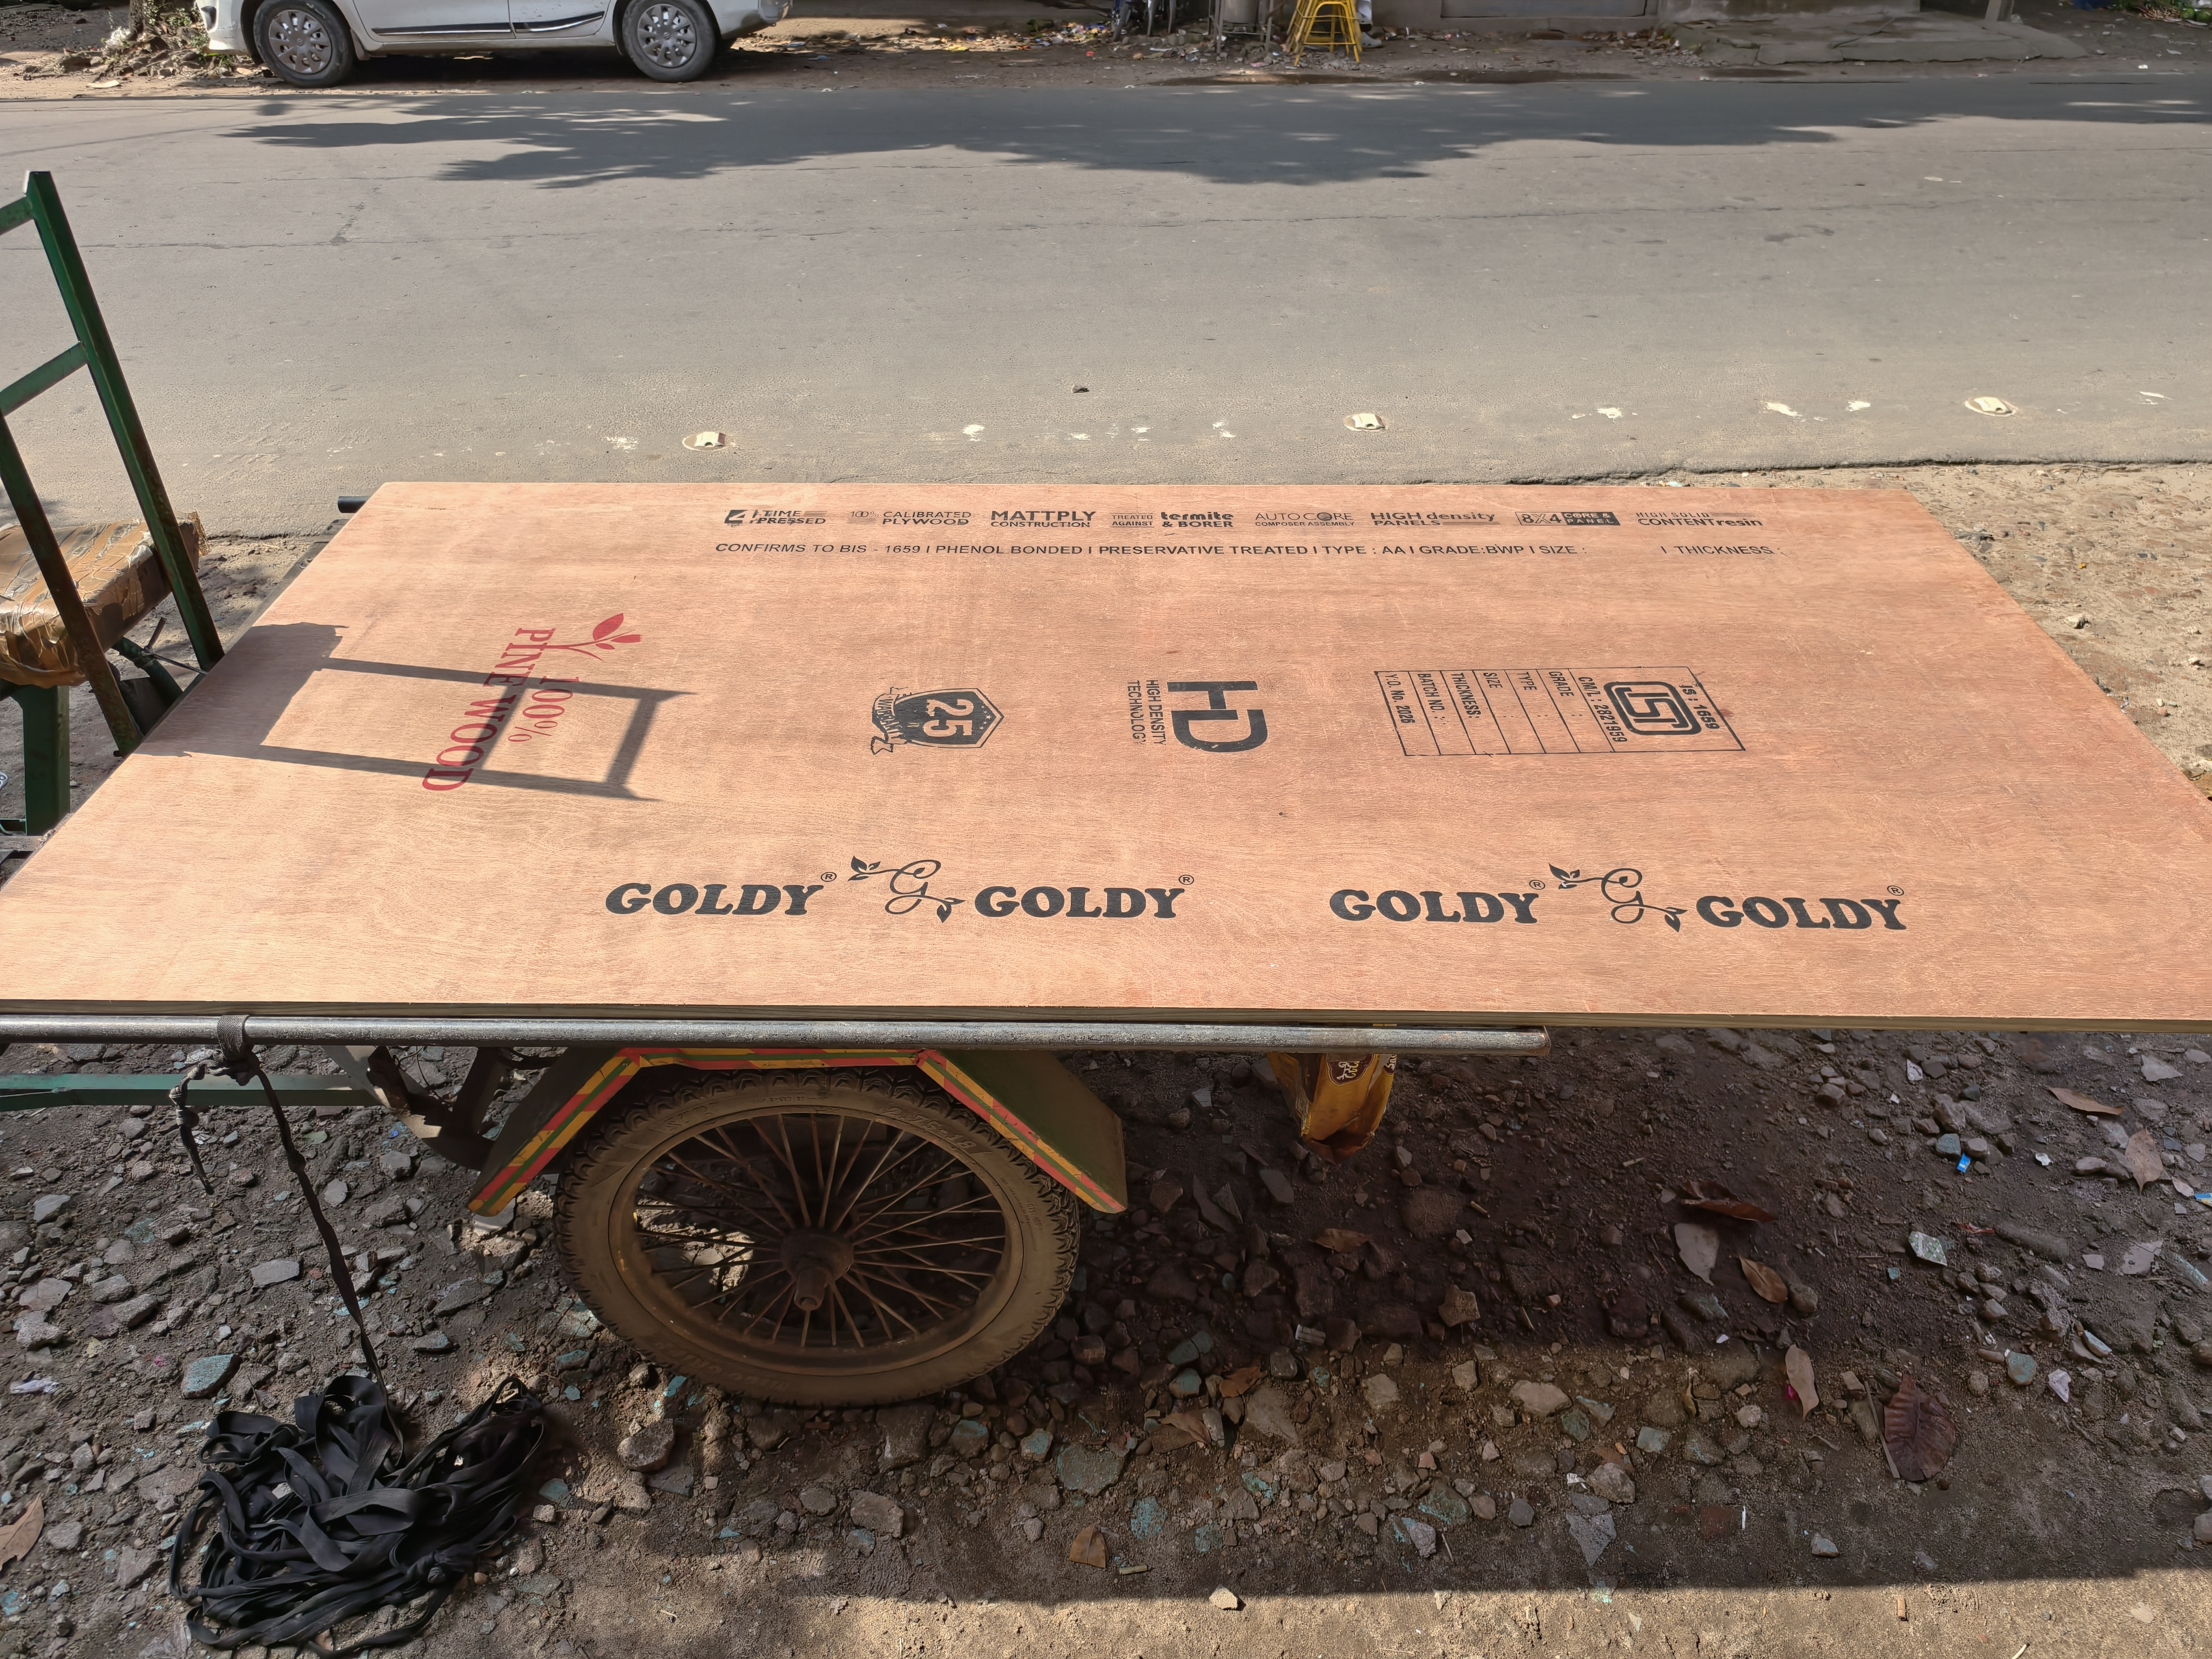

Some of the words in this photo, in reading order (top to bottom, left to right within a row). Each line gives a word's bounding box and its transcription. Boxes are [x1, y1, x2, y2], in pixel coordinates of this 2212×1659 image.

[991, 510, 1097, 521] MATTPLY
[1161, 511, 1234, 521] termite
[1371, 512, 1422, 520] HIGH
[1426, 512, 1495, 522] density
[1521, 513, 1563, 524] 8X4
[716, 543, 806, 552] CONFIRMS
[813, 544, 834, 552] TO
[840, 545, 867, 553] BIS
[885, 545, 921, 554] 1659
[936, 545, 1005, 554] PHENOL
[1011, 545, 1083, 554] BONDED
[1099, 546, 1225, 555] PRESERVATIVE
[1230, 546, 1308, 555] TREATED
[1323, 546, 1367, 555] TYPE
[1382, 546, 1405, 555] AA
[1539, 545, 1578, 554] SIZE
[482, 628, 557, 687] PINE
[1146, 680, 1162, 702] HIGH
[1418, 673, 1439, 697] BATCH
[1483, 672, 1503, 689] SIZE
[1516, 671, 1538, 691] TYPE
[1548, 671, 1575, 697] GRADE
[508, 676, 580, 743] 100%
[922, 698, 974, 738] 25
[1127, 680, 1147, 745] TECHNOLOGY
[1396, 705, 1415, 724] 2026
[1427, 699, 1445, 713] NO.
[1578, 676, 1602, 697] CM/L
[1593, 704, 1628, 743] 2821959
[1678, 685, 1697, 695] IS
[1693, 704, 1720, 730] 1659
[1148, 704, 1166, 745] DENSITY
[422, 694, 517, 792] WOOD
[605, 882, 824, 916] GOLDY
[974, 886, 1185, 919] GOLDY
[1329, 889, 1539, 924] GOLDY
[1696, 895, 1907, 930] GOLDY
